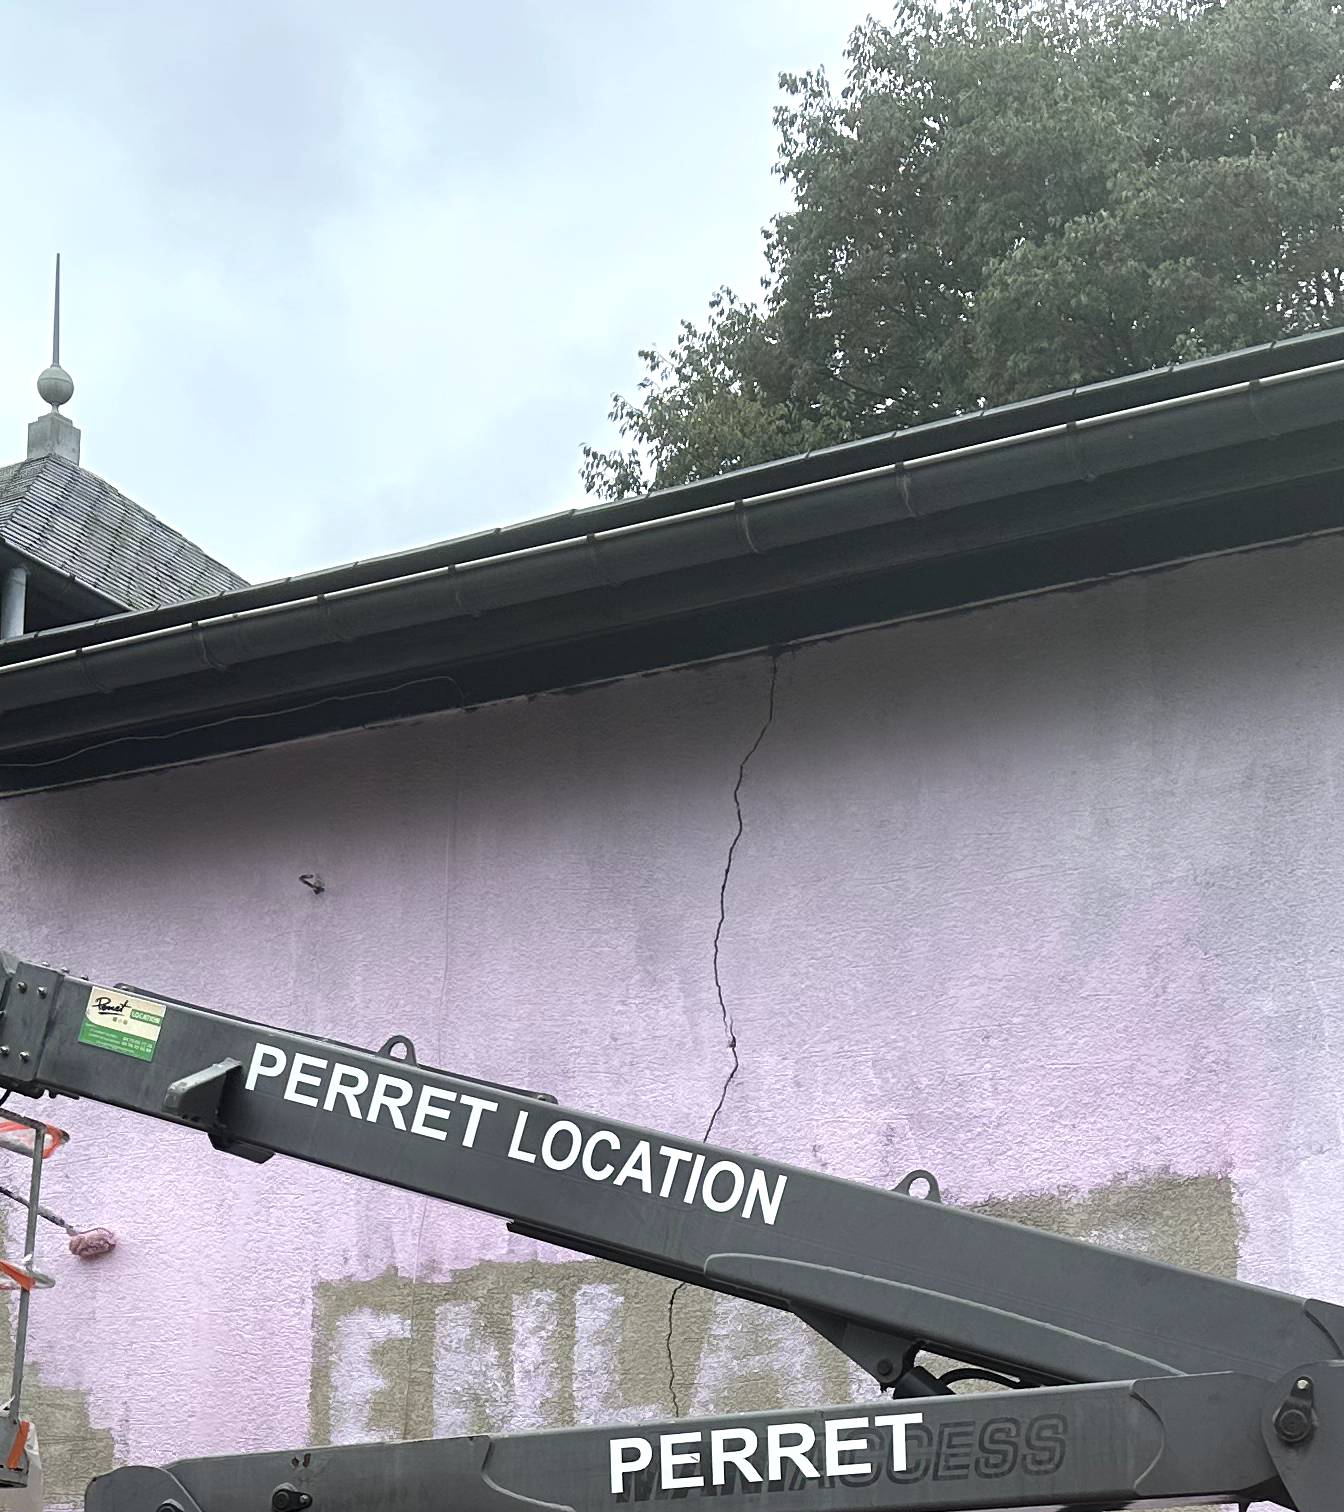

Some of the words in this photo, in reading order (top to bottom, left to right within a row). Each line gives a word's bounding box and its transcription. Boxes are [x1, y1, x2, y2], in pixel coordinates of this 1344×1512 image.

[244, 1042, 499, 1148] PERRET
[507, 1110, 788, 1226] LOCATION
[609, 1412, 923, 1495] PERRET
